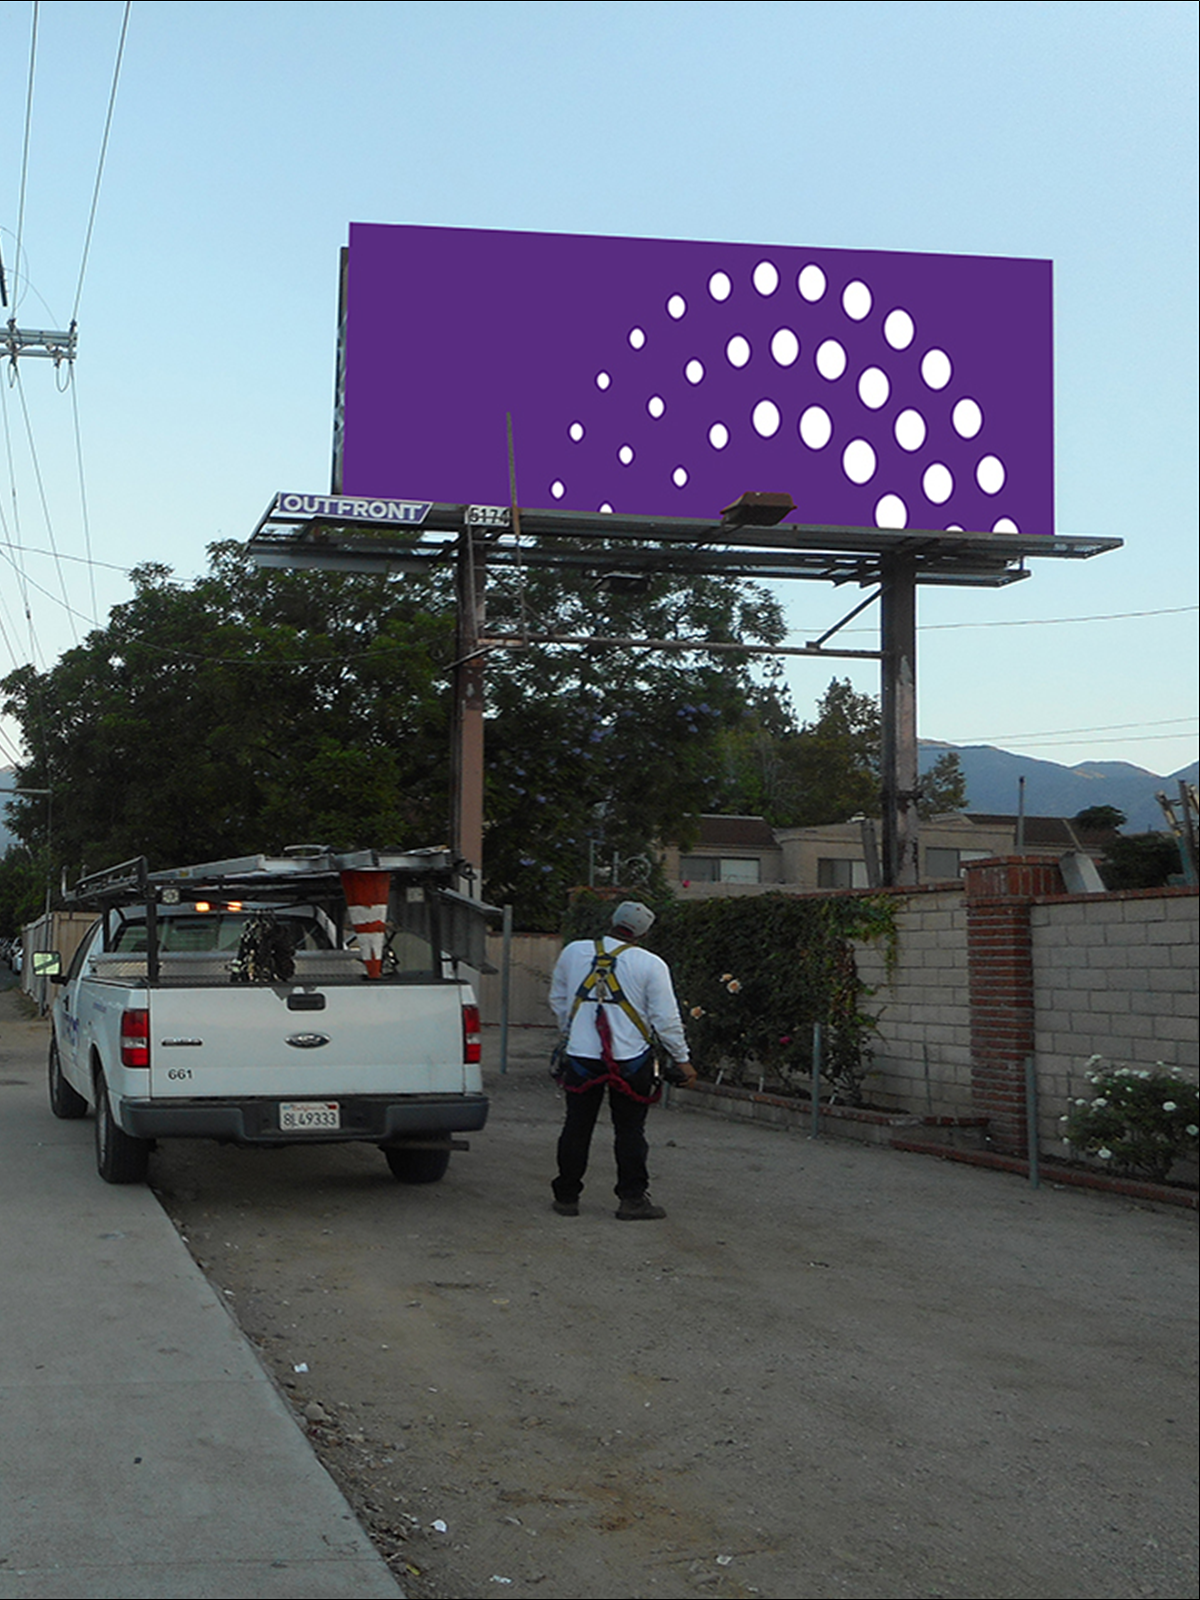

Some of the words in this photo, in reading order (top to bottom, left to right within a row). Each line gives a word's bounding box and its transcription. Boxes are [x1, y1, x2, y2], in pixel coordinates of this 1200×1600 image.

[283, 495, 423, 520] OUTFRONT
[168, 1068, 193, 1080] 661
[283, 1111, 337, 1127] 8L49333
